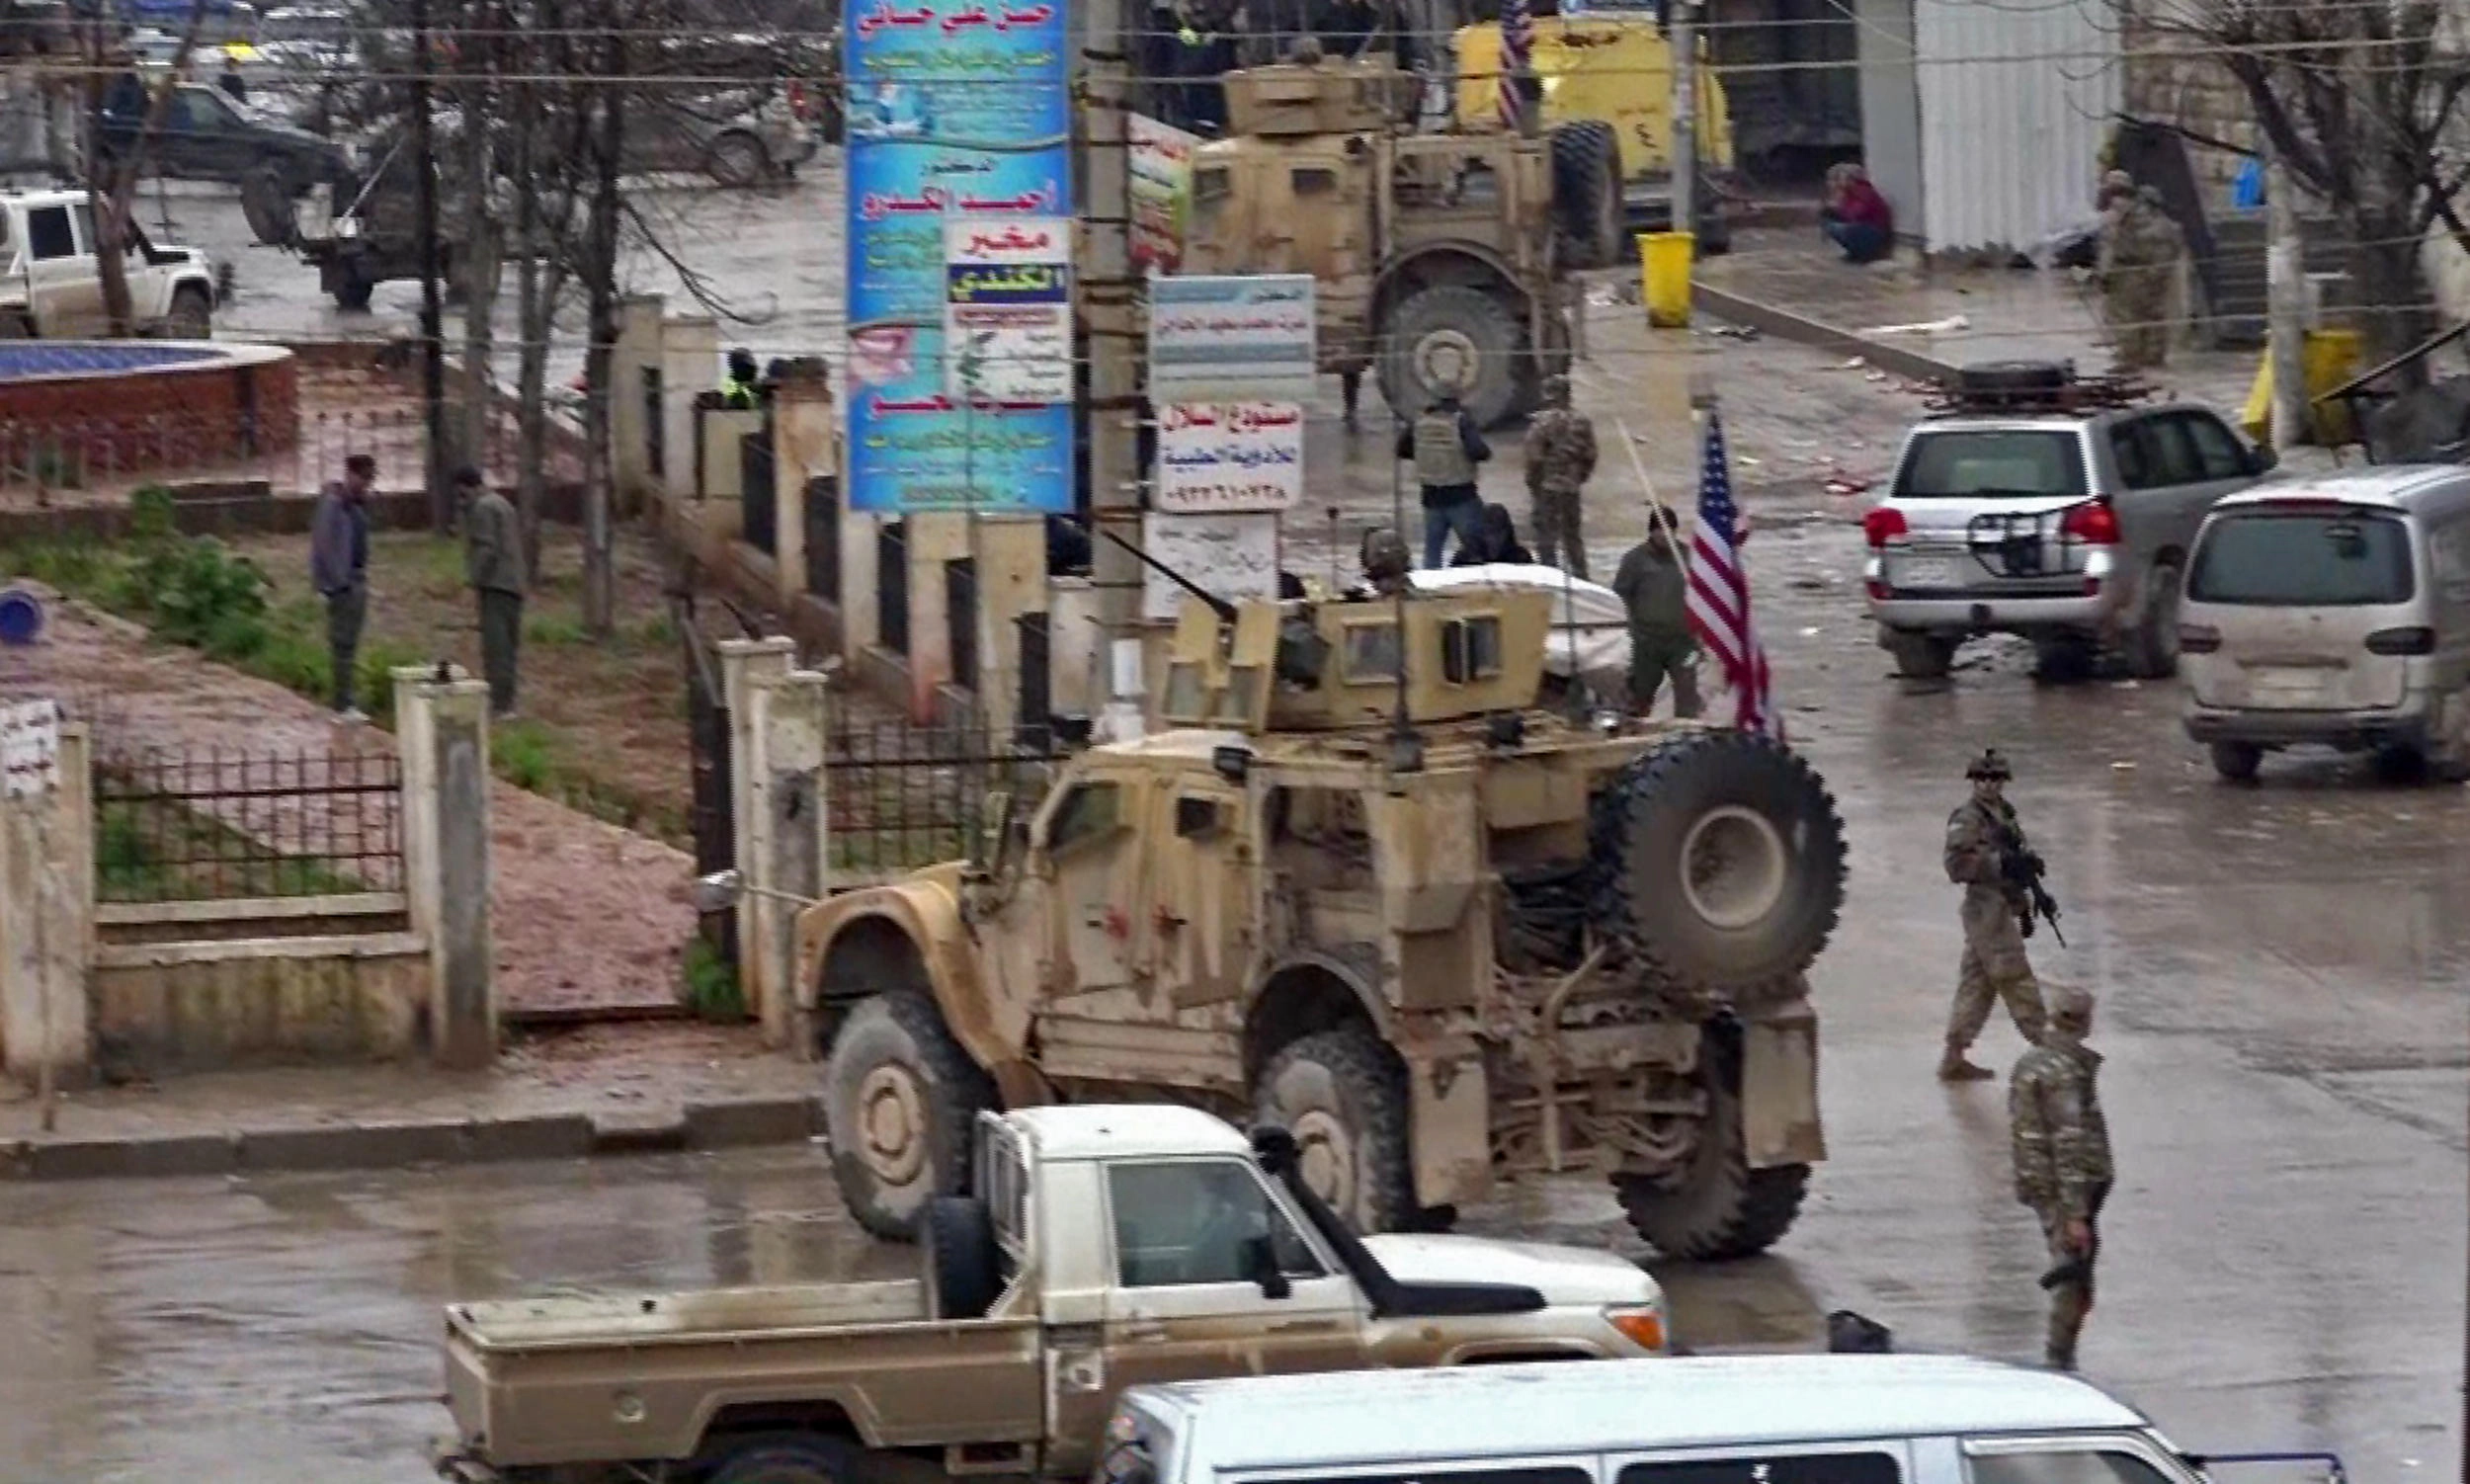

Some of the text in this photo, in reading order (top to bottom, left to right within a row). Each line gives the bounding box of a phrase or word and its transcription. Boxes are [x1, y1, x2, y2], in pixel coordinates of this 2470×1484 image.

[961, 224, 1050, 258] مخبر
[949, 265, 1066, 301] الكندي
[1227, 401, 1299, 435] مستودع
